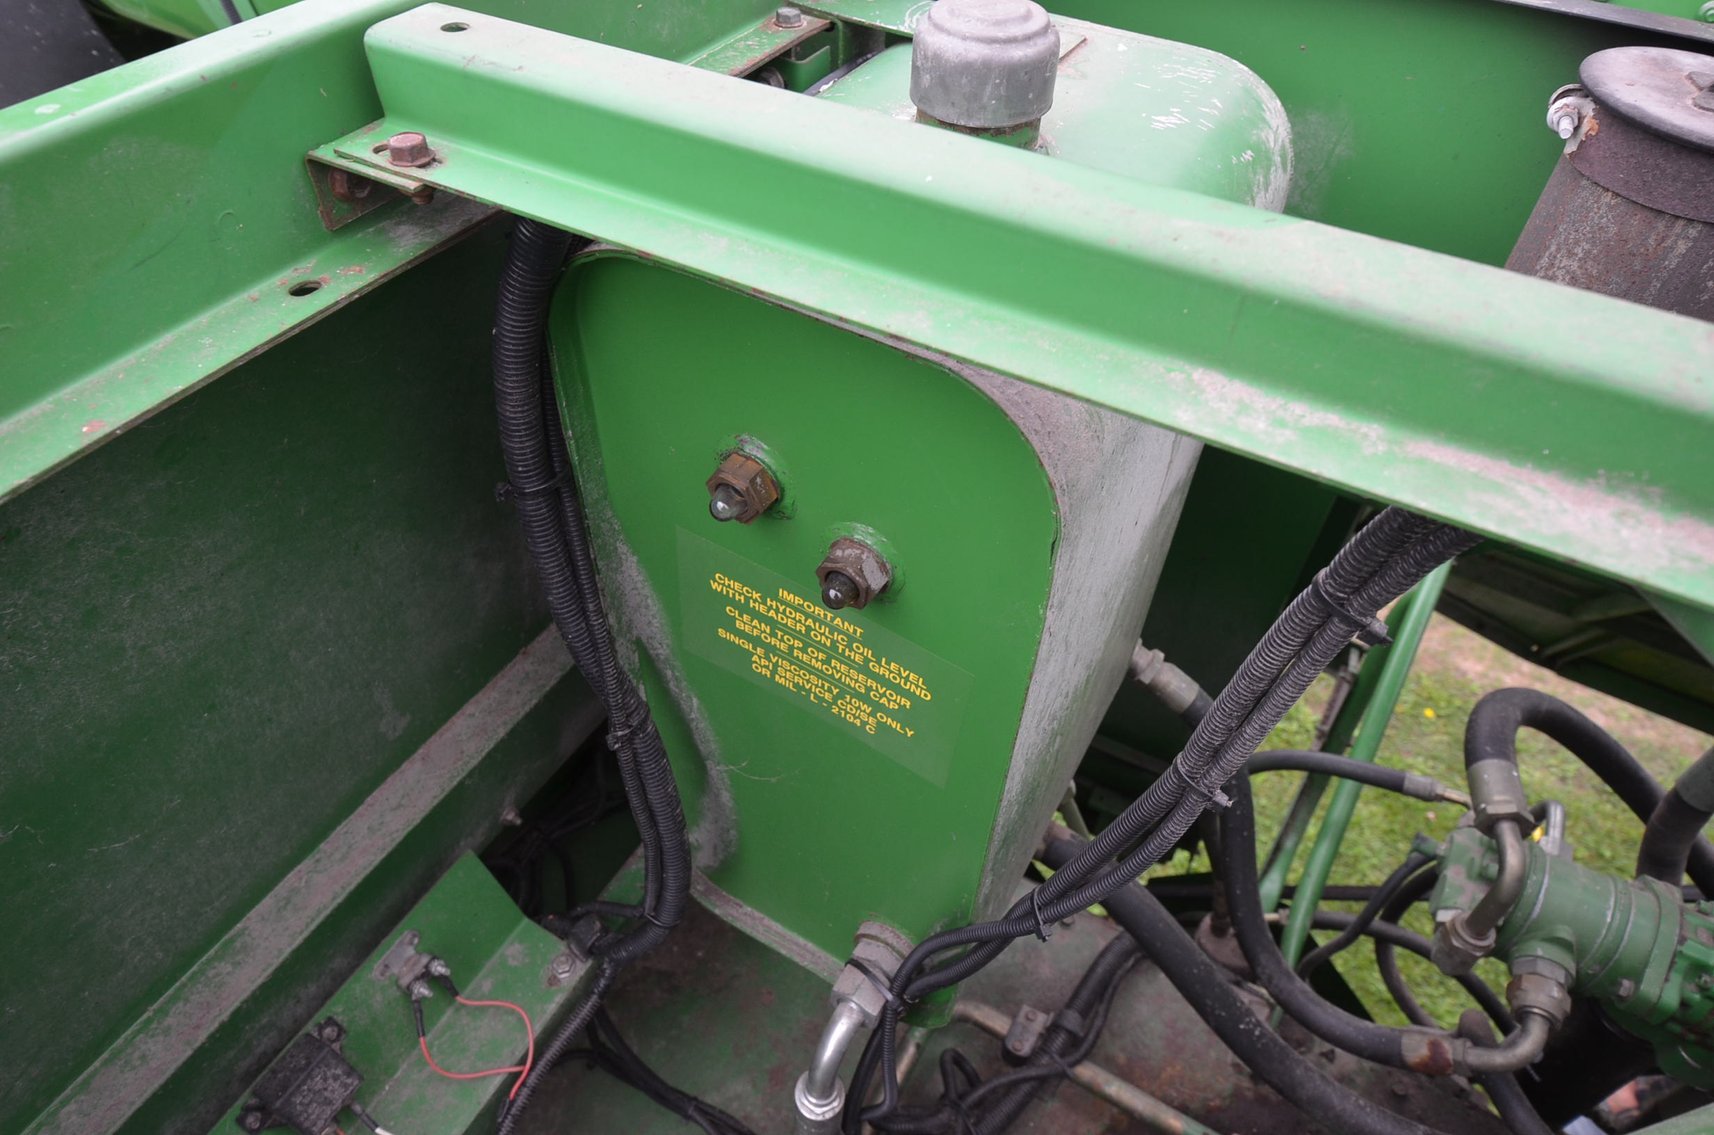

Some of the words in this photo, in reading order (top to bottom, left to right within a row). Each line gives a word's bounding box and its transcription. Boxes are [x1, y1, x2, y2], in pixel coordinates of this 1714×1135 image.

[710, 580, 744, 603] WITH
[750, 601, 806, 633] HEADER
[811, 632, 830, 647] ON
[837, 645, 863, 664] THE
[869, 663, 931, 700] GROUND
[715, 573, 761, 601] CHECK
[767, 598, 847, 645] HYDRAULIC
[853, 644, 876, 661] OIL
[882, 658, 927, 688] LEVEL
[726, 607, 770, 633] CLEAN
[776, 630, 803, 648] TOP
[808, 648, 826, 661] OF
[831, 659, 911, 708] RESERVOIR
[779, 589, 863, 637] IMPORTANT
[718, 628, 765, 657] SINGLE
[769, 654, 839, 695] VISCOSITY
[844, 695, 871, 714] 10W
[877, 713, 914, 737] ONLY
[736, 620, 788, 652] BEFORE
[794, 649, 865, 693] REMOVING
[870, 692, 898, 710] CAP
[752, 655, 772, 670] API
[777, 668, 833, 701] SERVICE
[752, 664, 770, 677] OR
[775, 675, 796, 691] MIL
[810, 694, 818, 703] L
[831, 706, 861, 726] 2104
[866, 725, 876, 734] C
